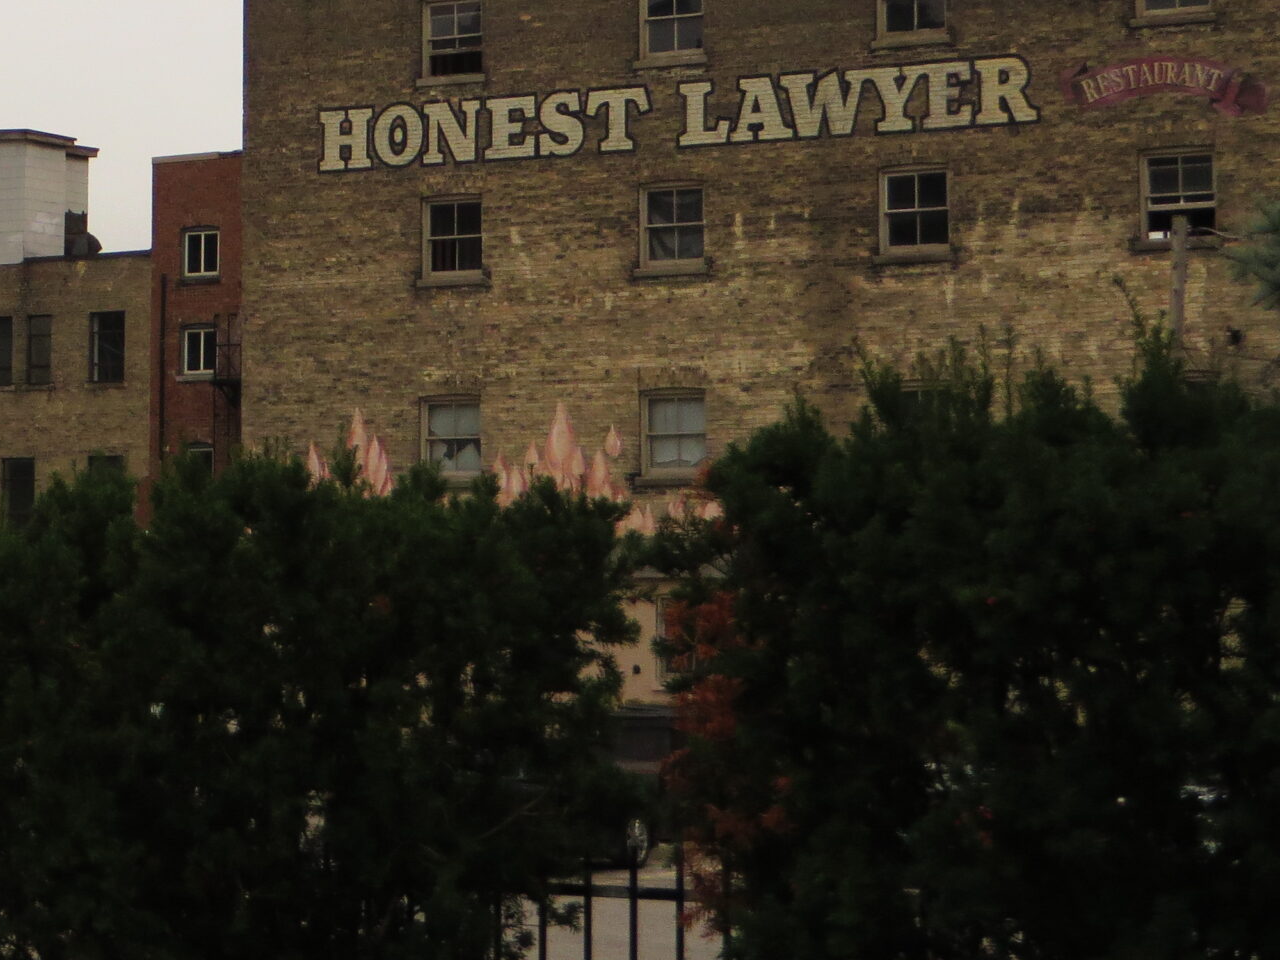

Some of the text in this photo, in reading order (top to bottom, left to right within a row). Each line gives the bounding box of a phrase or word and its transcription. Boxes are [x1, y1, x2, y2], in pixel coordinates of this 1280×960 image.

[318, 53, 1041, 173] HONEST LAWYER
[1080, 61, 1224, 103] RESTAURANT
